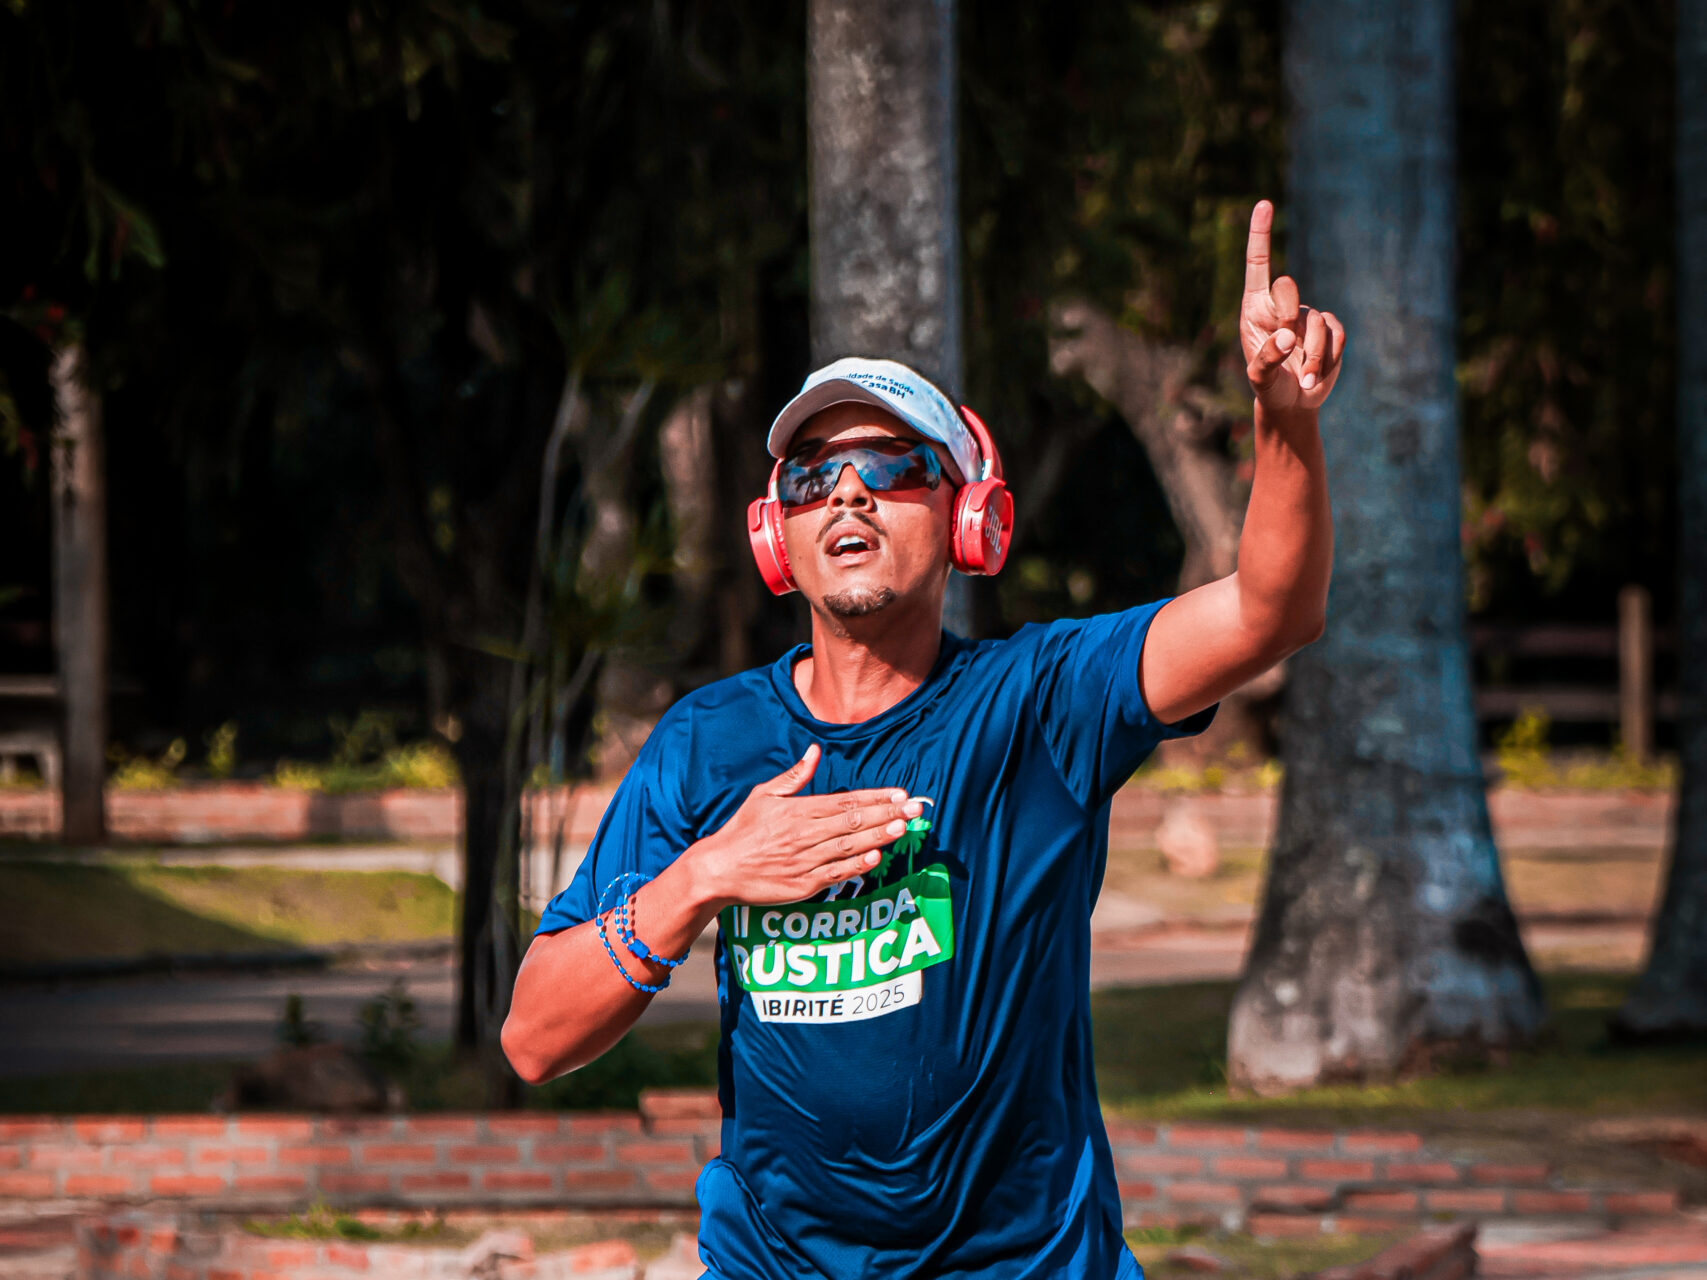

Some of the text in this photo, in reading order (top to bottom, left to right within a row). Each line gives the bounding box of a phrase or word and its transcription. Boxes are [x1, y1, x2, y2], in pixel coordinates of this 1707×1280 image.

[761, 887, 917, 940] CORRIDA
[732, 916, 942, 987] RÚSTICA
[762, 983, 905, 1017] IBIRITÉ 2025
